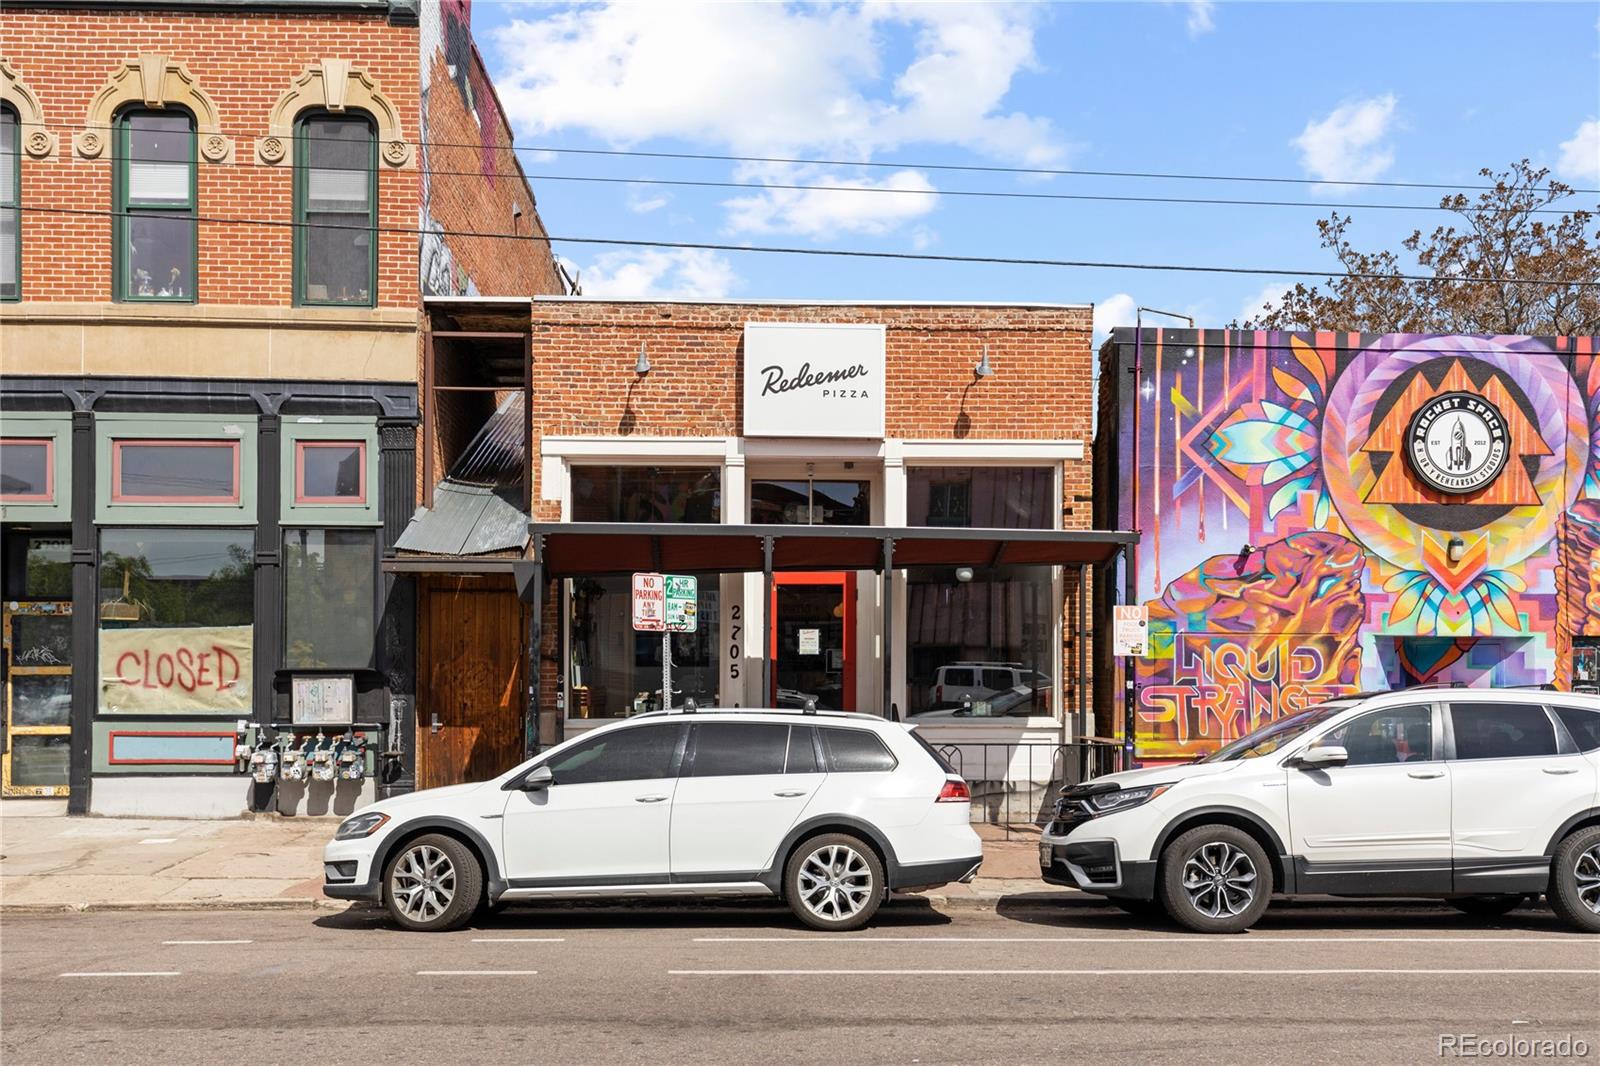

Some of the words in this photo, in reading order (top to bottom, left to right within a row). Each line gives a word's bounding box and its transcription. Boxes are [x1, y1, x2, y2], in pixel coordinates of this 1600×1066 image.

[761, 362, 869, 397] Redeemer
[822, 390, 869, 398] PIZZA
[1415, 398, 1460, 437] ROCKET
[1466, 399, 1503, 438] SPACE
[1416, 447, 1435, 476] HURY
[1435, 474, 1480, 487] REHEARSAL
[1479, 448, 1502, 478] STUDIOS
[643, 577, 655, 588] NO
[666, 579, 673, 595] 2
[634, 589, 663, 601] PARKING
[672, 588, 696, 598] PARKING
[642, 601, 656, 609] ANY
[1120, 607, 1142, 620] NO
[730, 605, 742, 679] 2705
[1173, 629, 1324, 686] LIQUID
[116, 645, 240, 692] CLOSED
